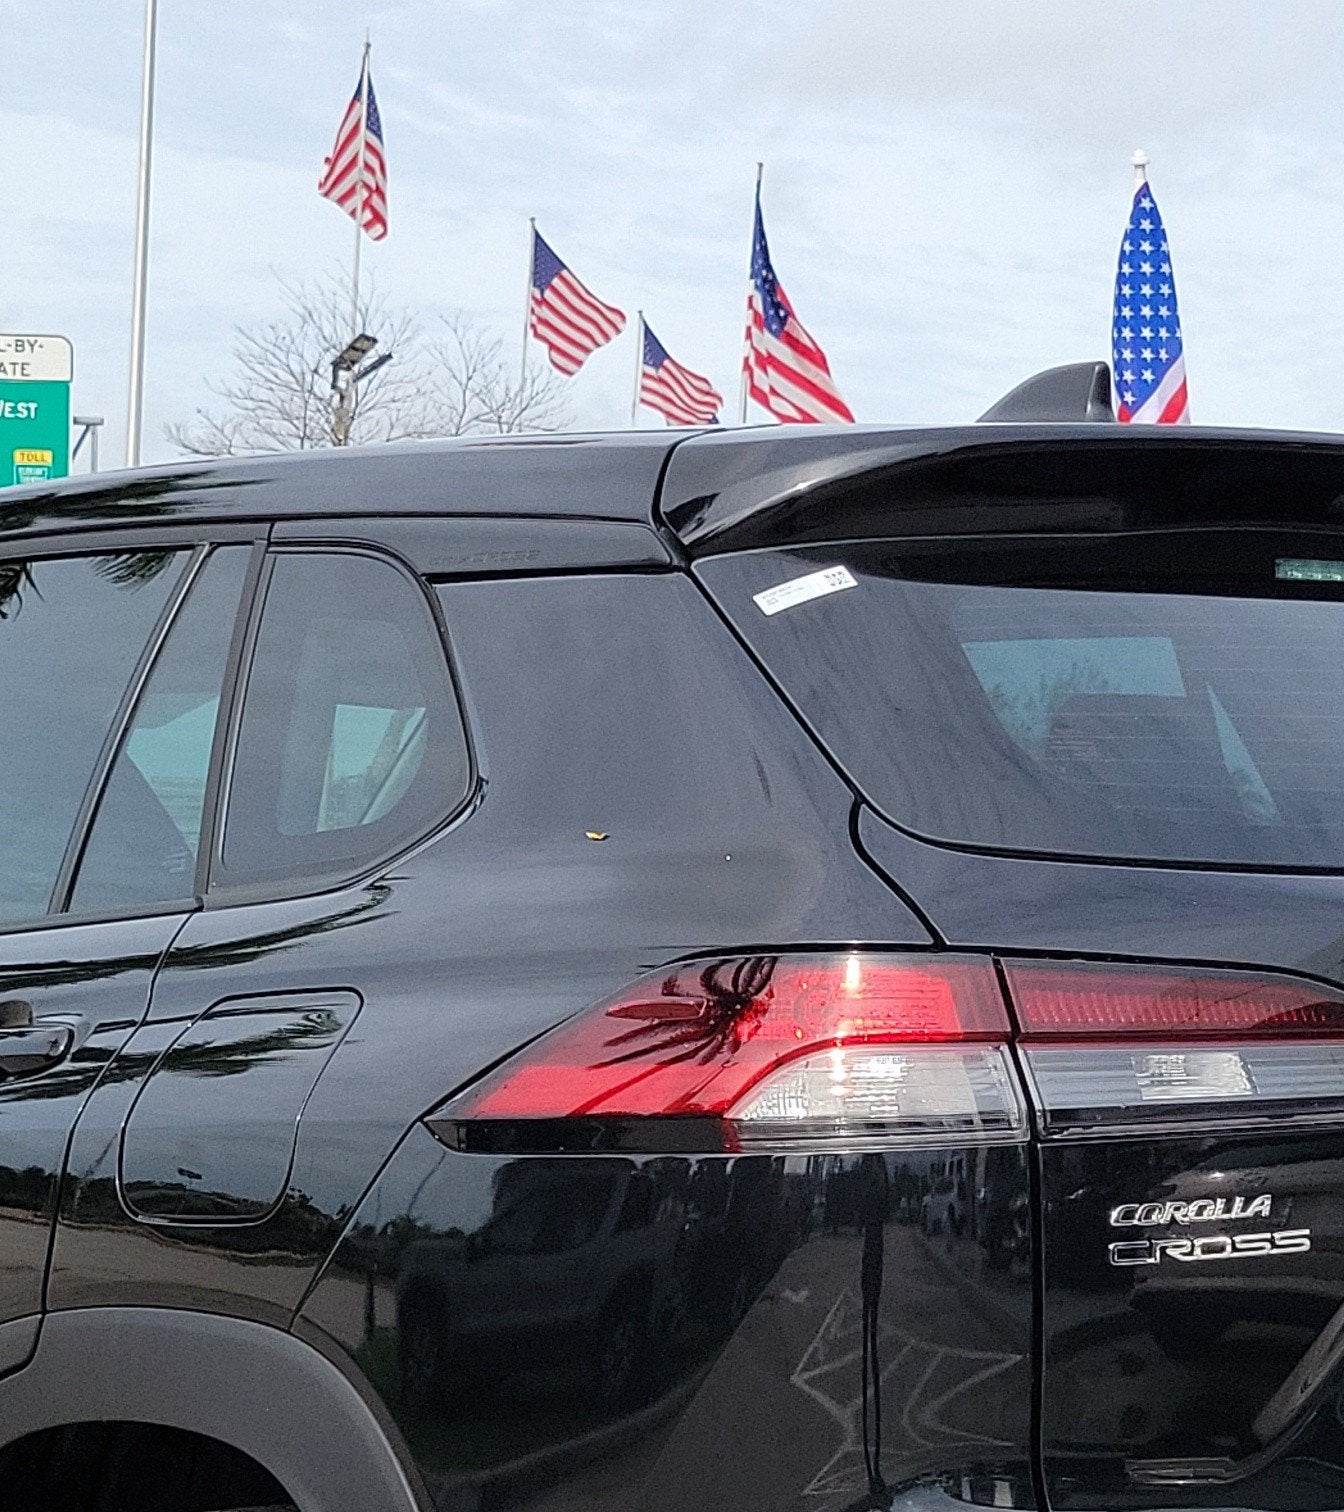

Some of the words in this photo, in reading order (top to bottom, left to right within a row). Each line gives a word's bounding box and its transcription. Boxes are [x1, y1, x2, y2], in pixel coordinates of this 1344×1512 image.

[19, 453, 47, 462] TOLL
[1109, 1194, 1272, 1226] COROLLA
[1108, 1229, 1311, 1266] CROSS
